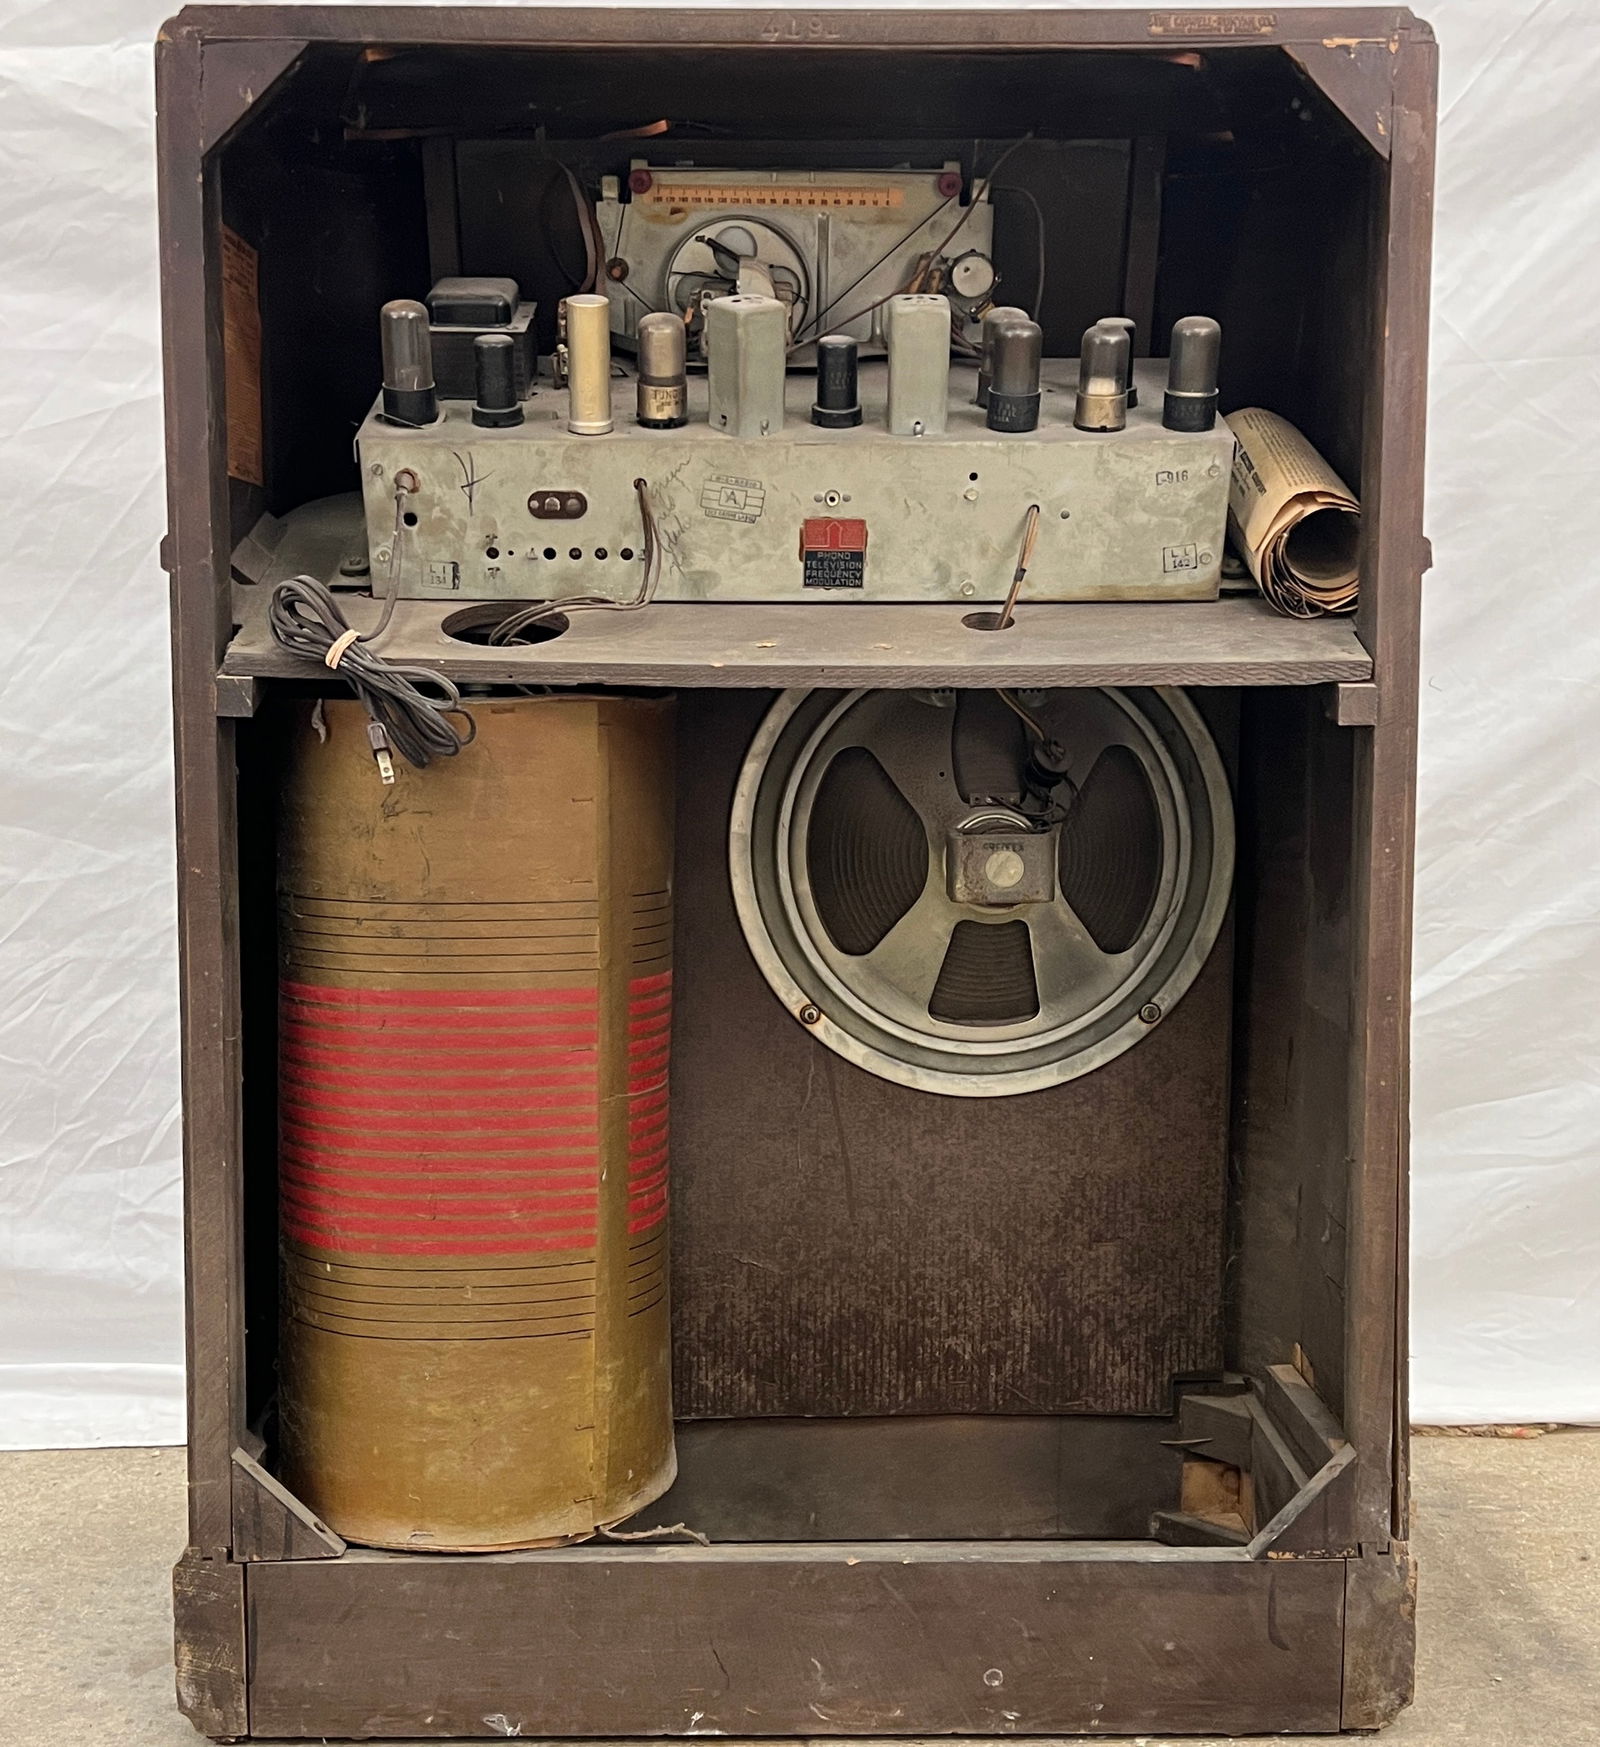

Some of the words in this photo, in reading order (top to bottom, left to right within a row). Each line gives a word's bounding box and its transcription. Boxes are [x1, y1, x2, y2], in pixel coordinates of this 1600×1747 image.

[817, 552, 851, 560] PHONO
[806, 561, 862, 569] TELEVISION
[806, 570, 862, 579] FREQUENCY
[806, 578, 862, 586] MODULATION
